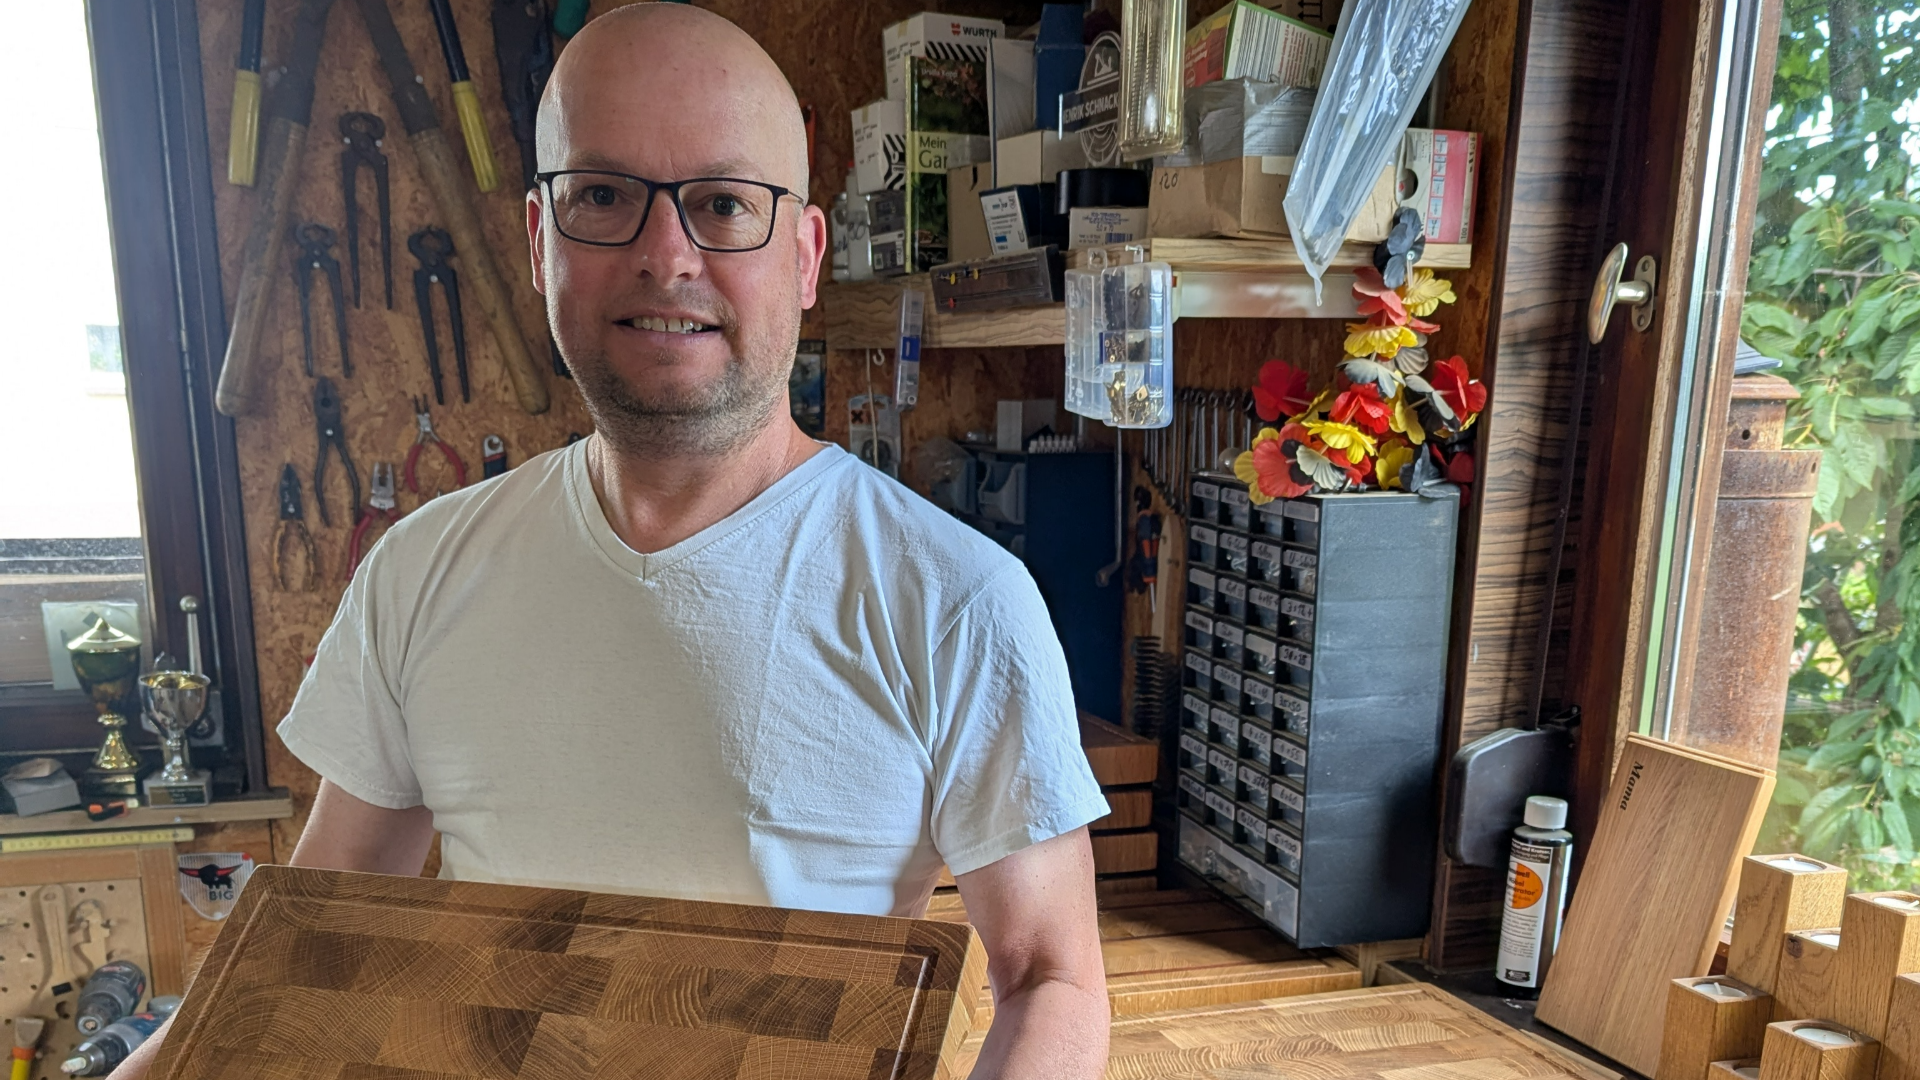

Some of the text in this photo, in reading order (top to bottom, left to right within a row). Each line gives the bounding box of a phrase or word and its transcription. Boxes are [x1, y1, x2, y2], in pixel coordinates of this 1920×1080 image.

[919, 136, 947, 149] Mein
[1159, 172, 1179, 190] 120
[1620, 761, 1644, 811] Mama
[209, 890, 234, 901] BIG
